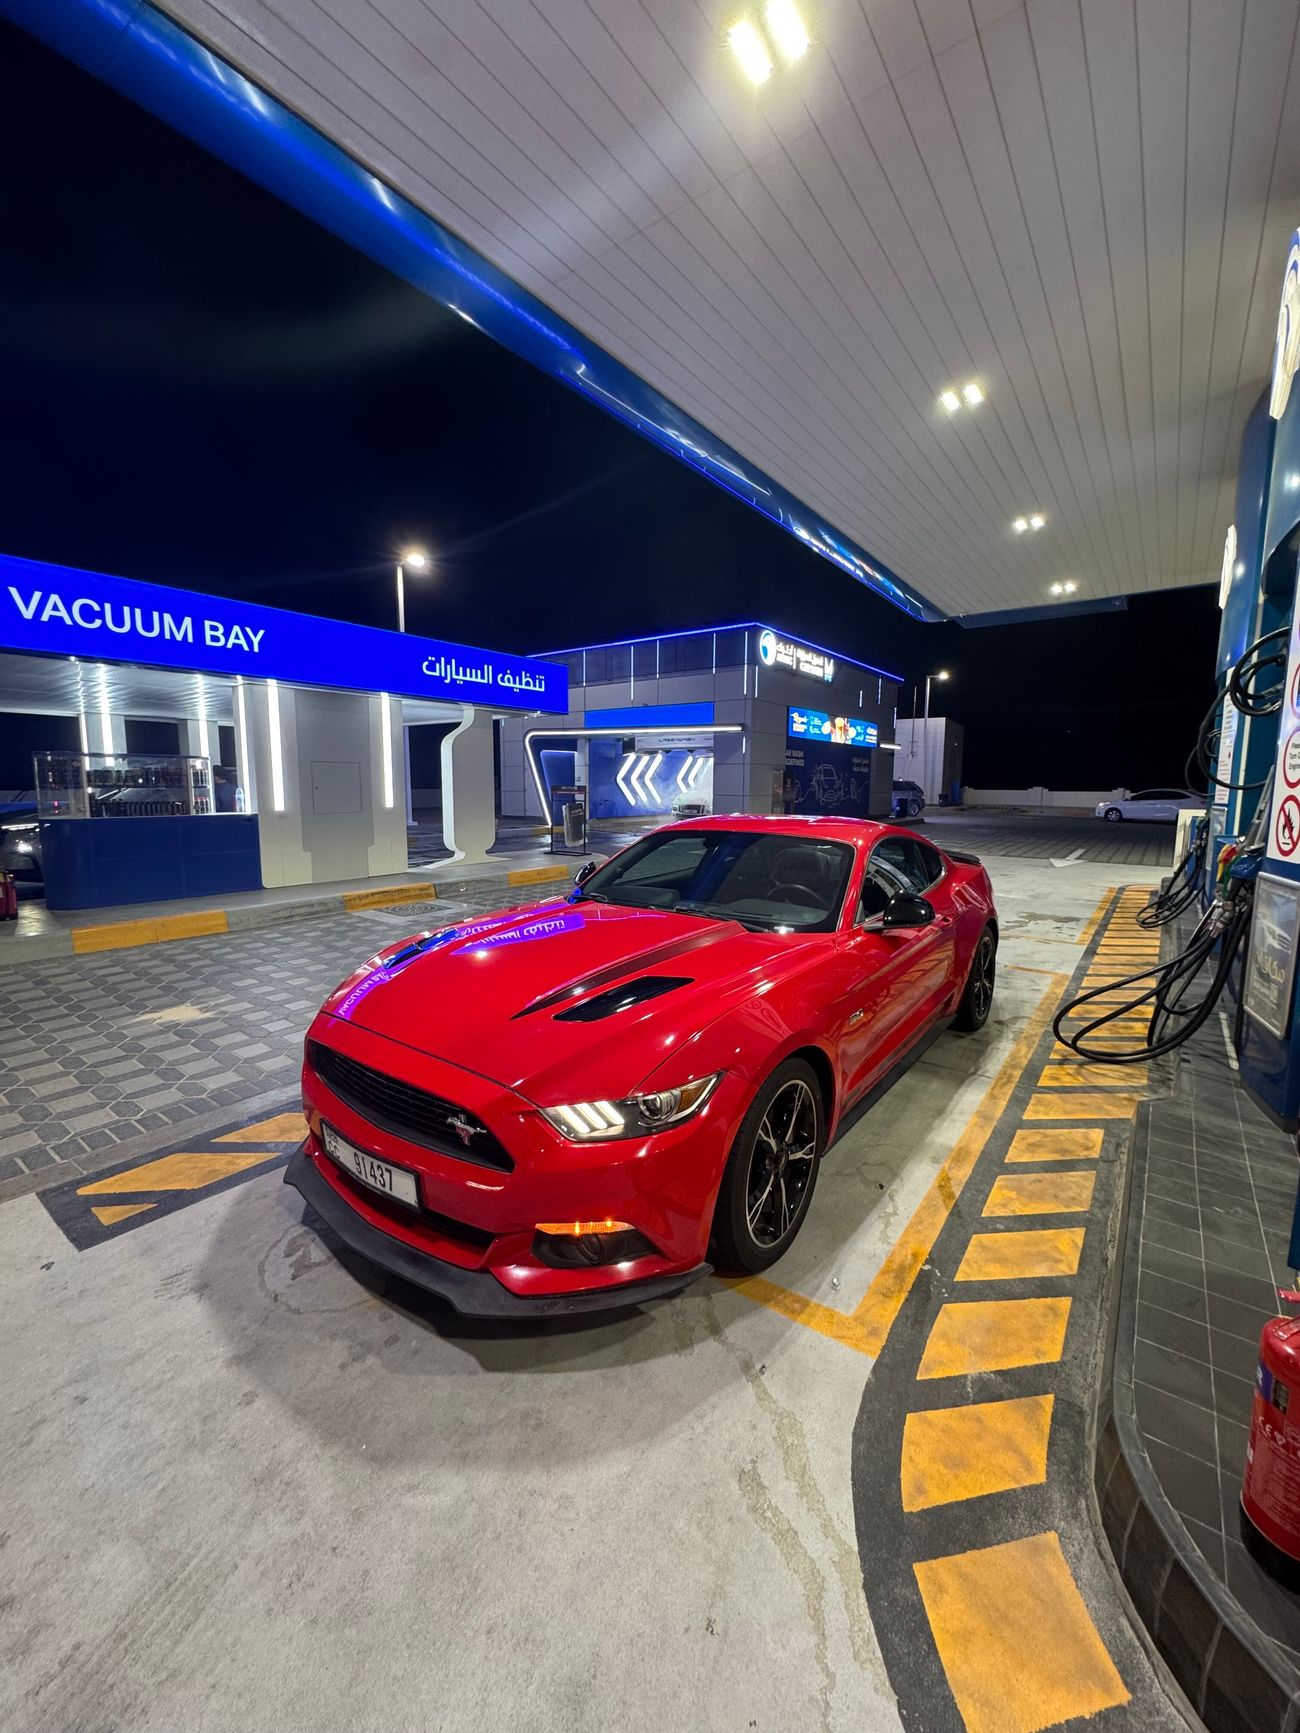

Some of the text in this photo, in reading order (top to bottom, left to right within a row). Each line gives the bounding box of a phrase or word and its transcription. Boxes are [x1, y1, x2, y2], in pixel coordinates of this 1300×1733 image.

[8, 586, 265, 653] VACUUM BAY
[422, 656, 545, 692] تنظيف السيارات
[353, 1151, 393, 1191] 91437
